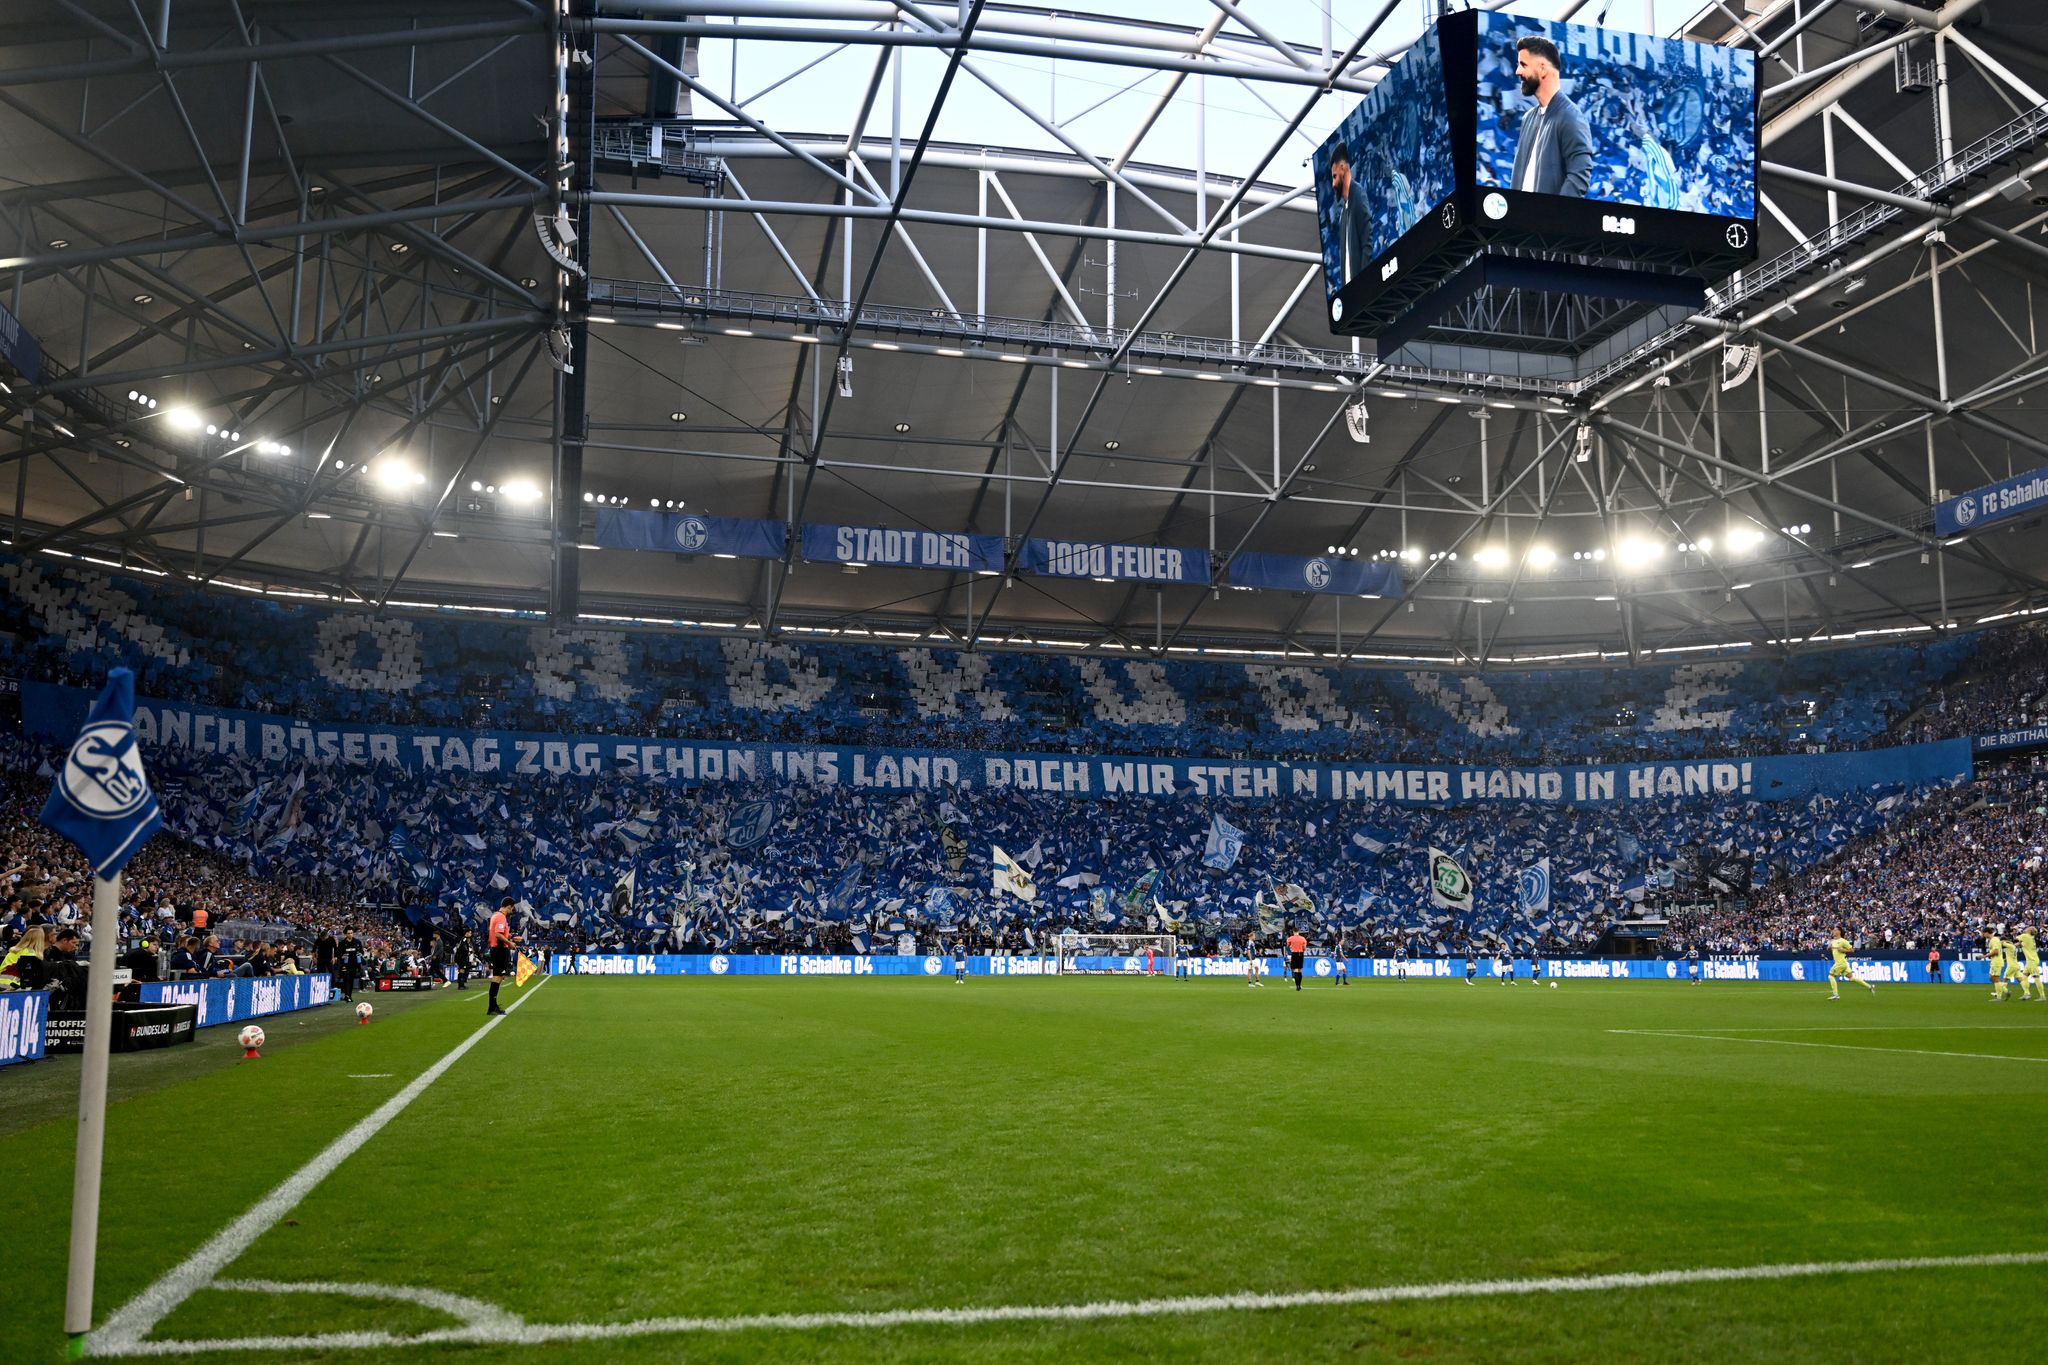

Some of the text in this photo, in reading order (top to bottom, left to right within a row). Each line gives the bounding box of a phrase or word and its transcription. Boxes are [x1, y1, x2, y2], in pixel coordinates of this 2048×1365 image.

[1982, 492, 1998, 515] FC
[837, 526, 970, 567] STADT DER
[1046, 541, 1183, 581] 1000 FEUER
[1980, 735, 1997, 747] DIE
[90, 701, 246, 757] ANCH
[261, 721, 398, 764] BÖSER
[413, 736, 499, 772] TAG
[515, 741, 600, 776] ZOG
[615, 745, 755, 782] SCHON
[772, 751, 838, 784] INS
[986, 758, 1089, 792] DOCH
[1102, 762, 1176, 794] WIR
[1331, 769, 1451, 801] IMMER
[1461, 770, 1562, 800] HAND
[1574, 770, 1615, 801] IN
[1629, 762, 1752, 798] HAND!
[1439, 866, 1457, 886] 75
[579, 955, 634, 974] Schalke
[637, 955, 656, 974] 04
[781, 956, 873, 974] FC Schalke 04
[990, 957, 1005, 974] FC
[1187, 958, 1202, 975] FC
[1373, 959, 1388, 976] FC
[1435, 959, 1451, 976] 04
[1549, 960, 1628, 977] FC Schalke 04
[1704, 961, 1760, 979] FC Schalke 04
[1852, 962, 1891, 981] Schalke
[1892, 962, 1908, 981] 04
[20, 995, 41, 1056] 04
[59, 1020, 86, 1028] OFFIZ
[136, 1024, 170, 1037] BUNDESLIGA
